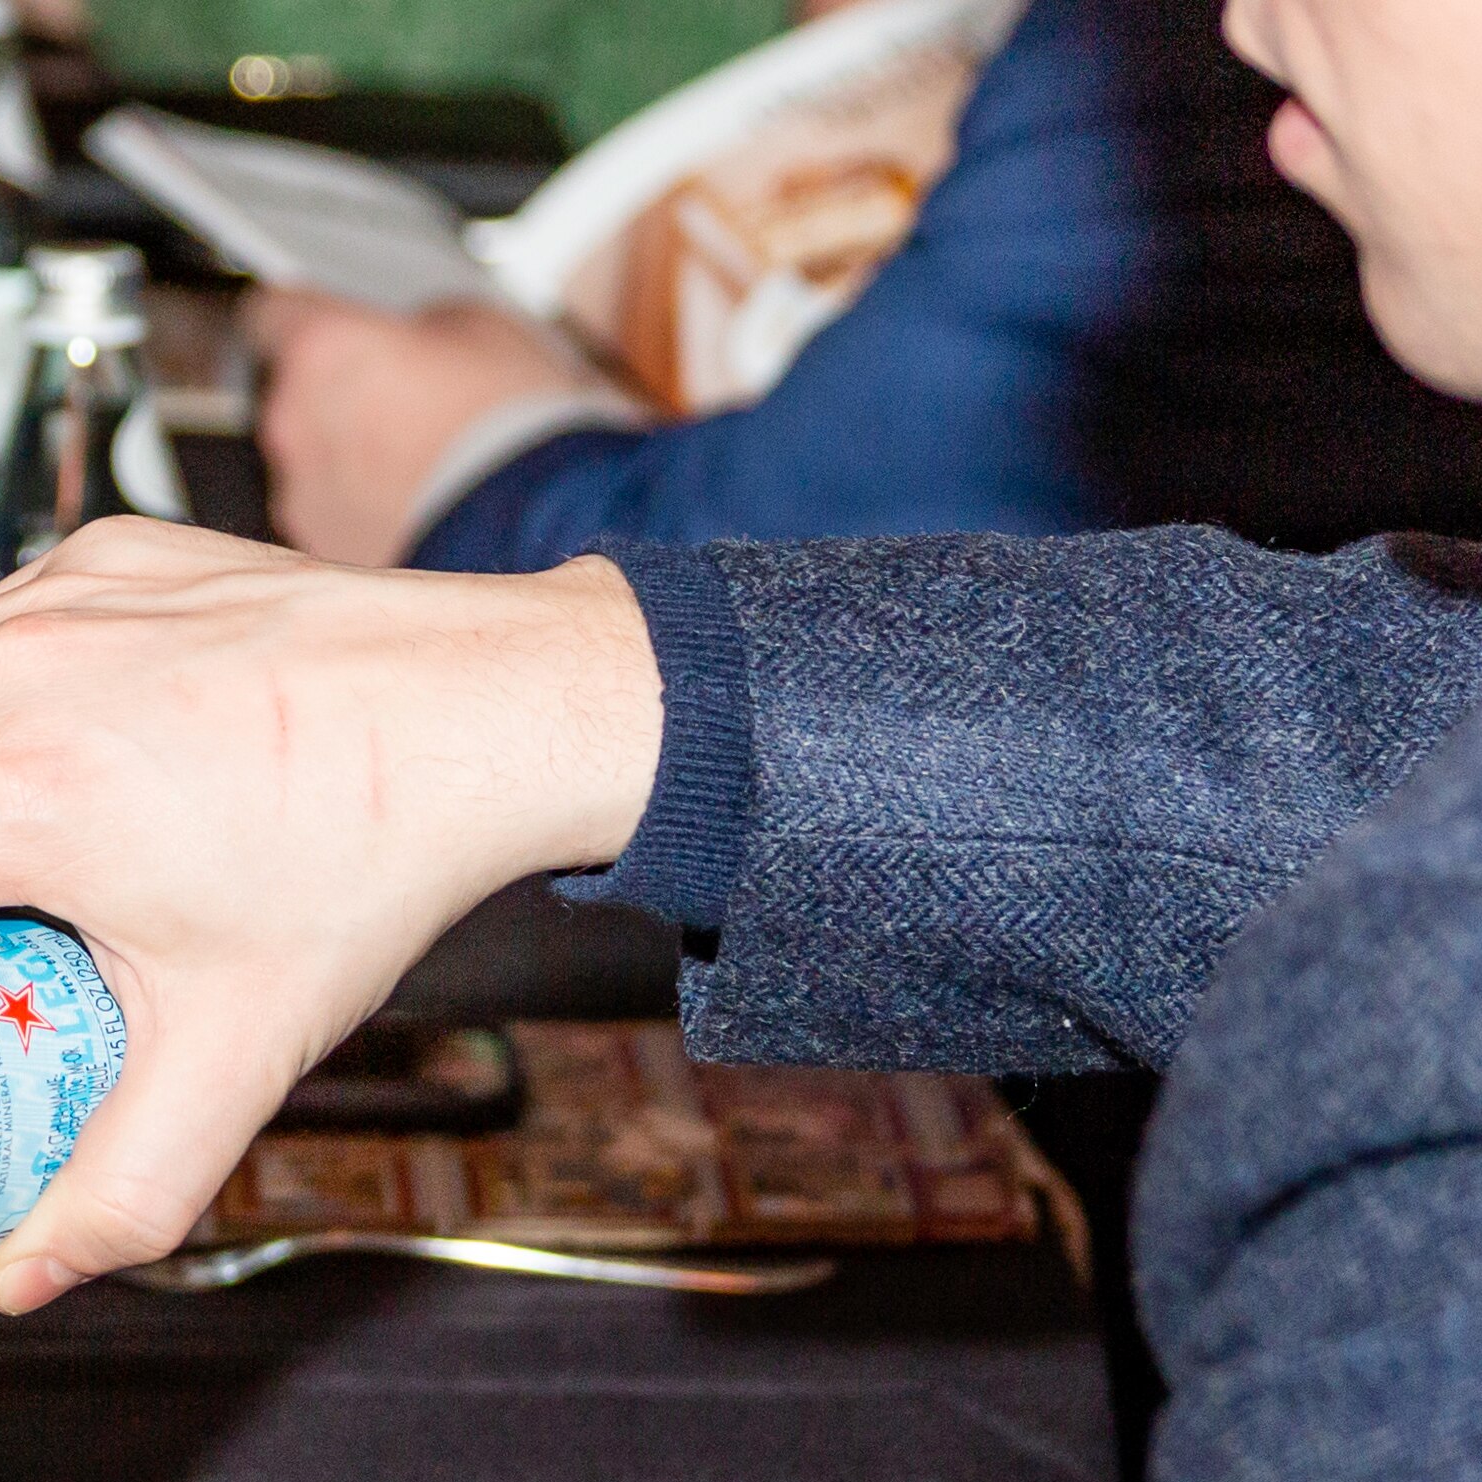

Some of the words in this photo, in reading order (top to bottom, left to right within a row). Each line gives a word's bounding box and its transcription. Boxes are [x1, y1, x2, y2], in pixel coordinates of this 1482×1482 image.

[64, 950, 101, 983] (250
[89, 985, 114, 1012] OZ
[104, 1014, 123, 1036] FL
[0, 1075, 13, 1132] MINERAL
